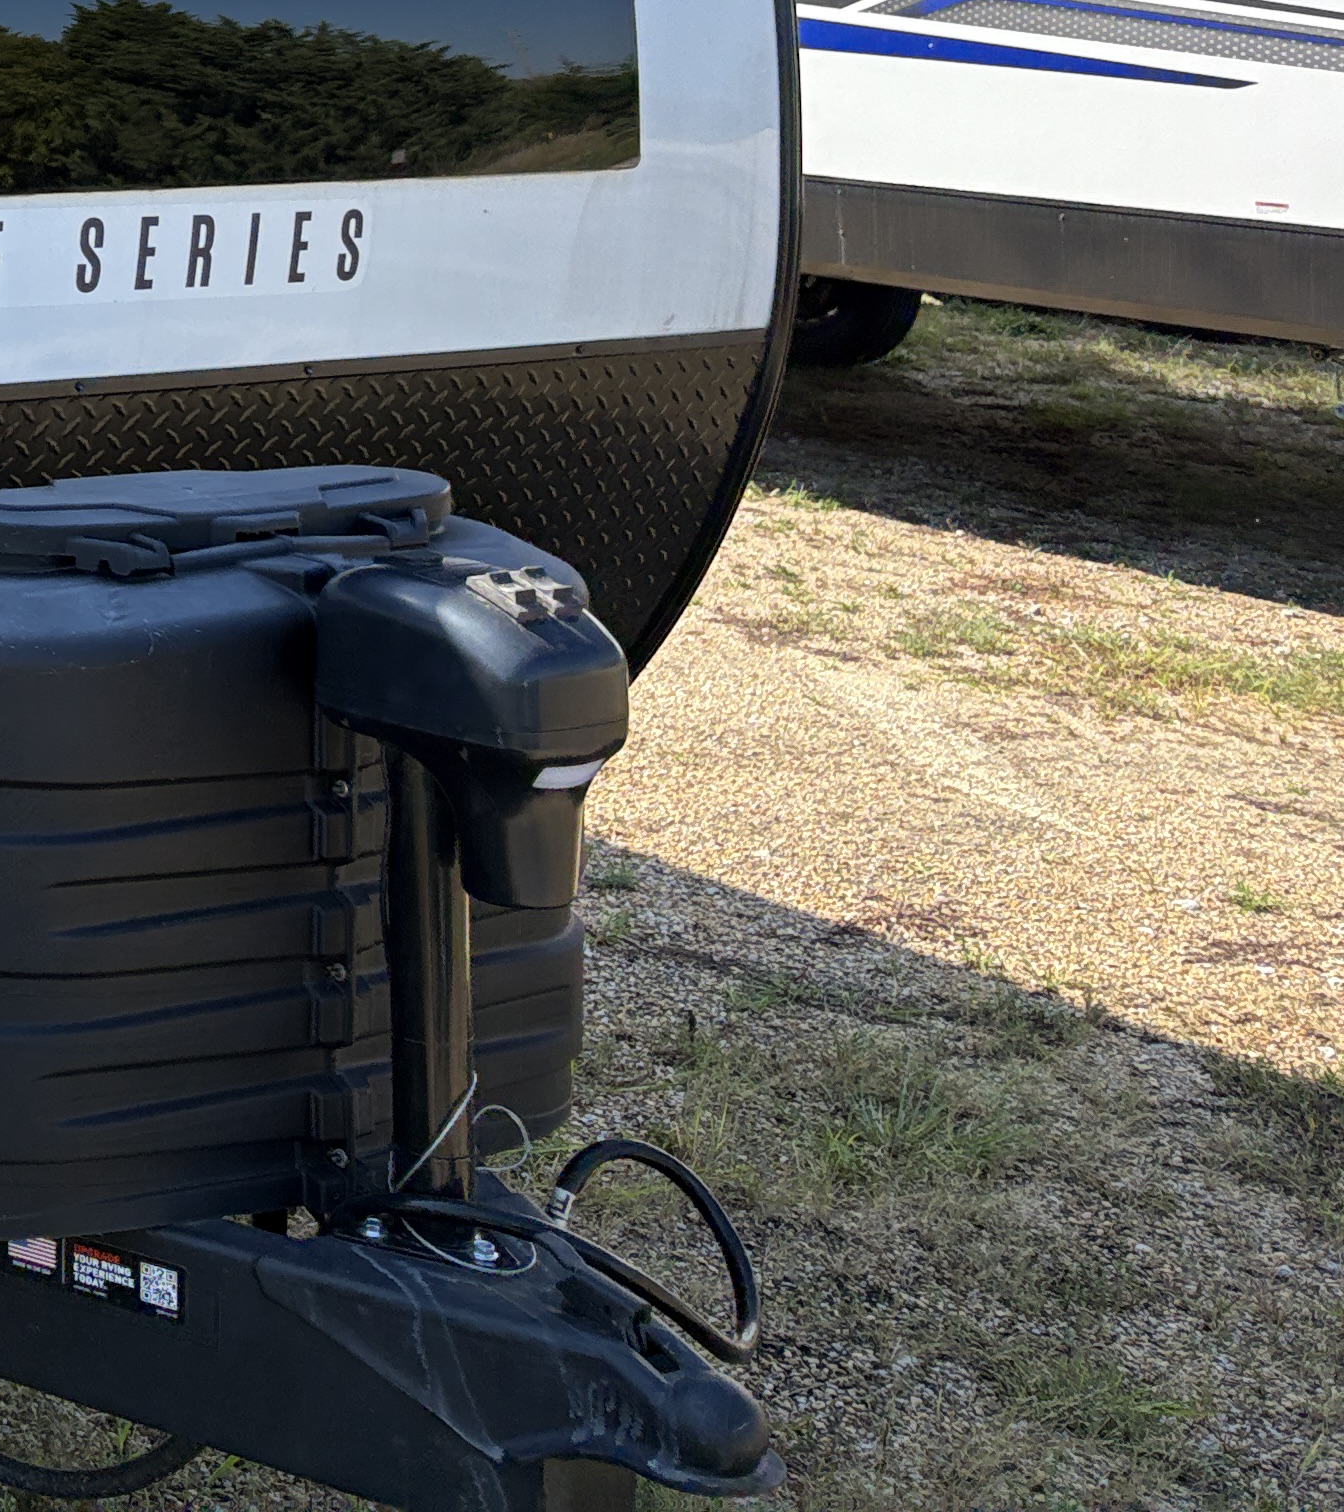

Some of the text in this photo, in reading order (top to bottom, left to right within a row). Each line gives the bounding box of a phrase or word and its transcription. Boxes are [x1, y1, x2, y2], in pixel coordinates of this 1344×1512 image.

[75, 208, 365, 293] SERIES
[73, 1252, 132, 1277] YOUR RVING
[73, 1262, 135, 1289] EXPERIENCE
